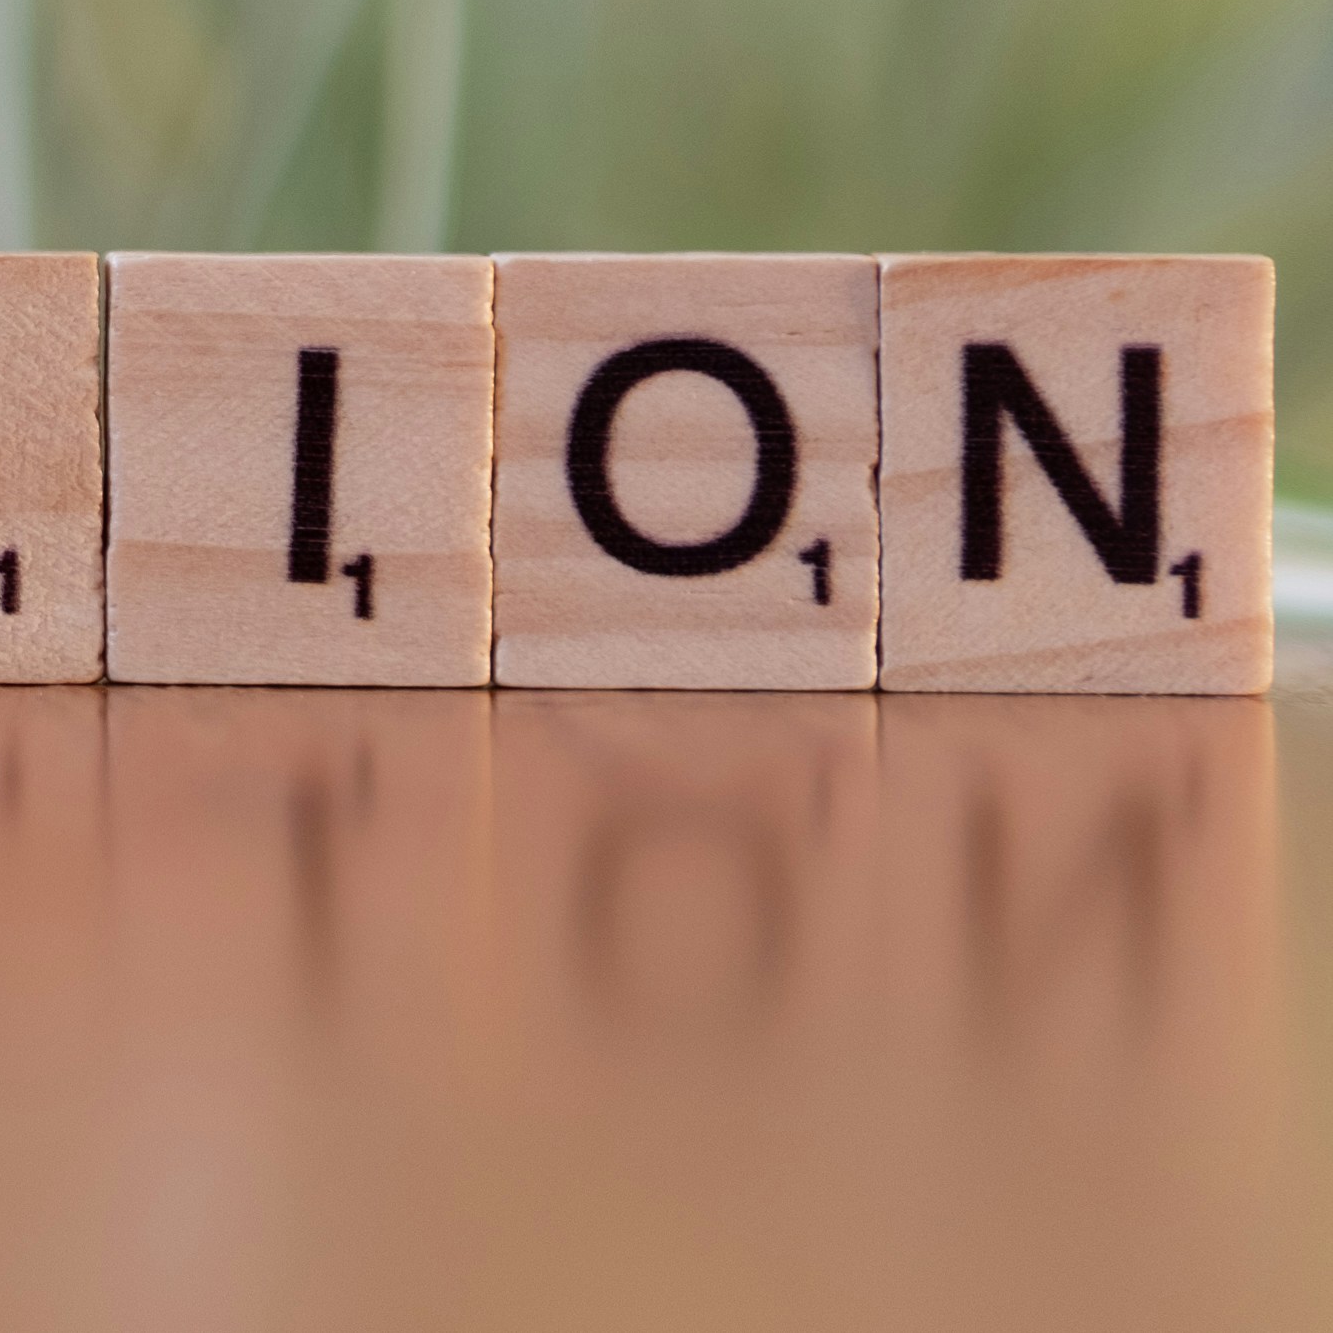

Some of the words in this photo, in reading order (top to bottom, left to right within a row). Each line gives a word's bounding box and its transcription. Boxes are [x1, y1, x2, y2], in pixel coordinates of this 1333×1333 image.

[340, 553, 377, 621] 1
[796, 538, 833, 607] 1
[1167, 551, 1203, 620] 1
